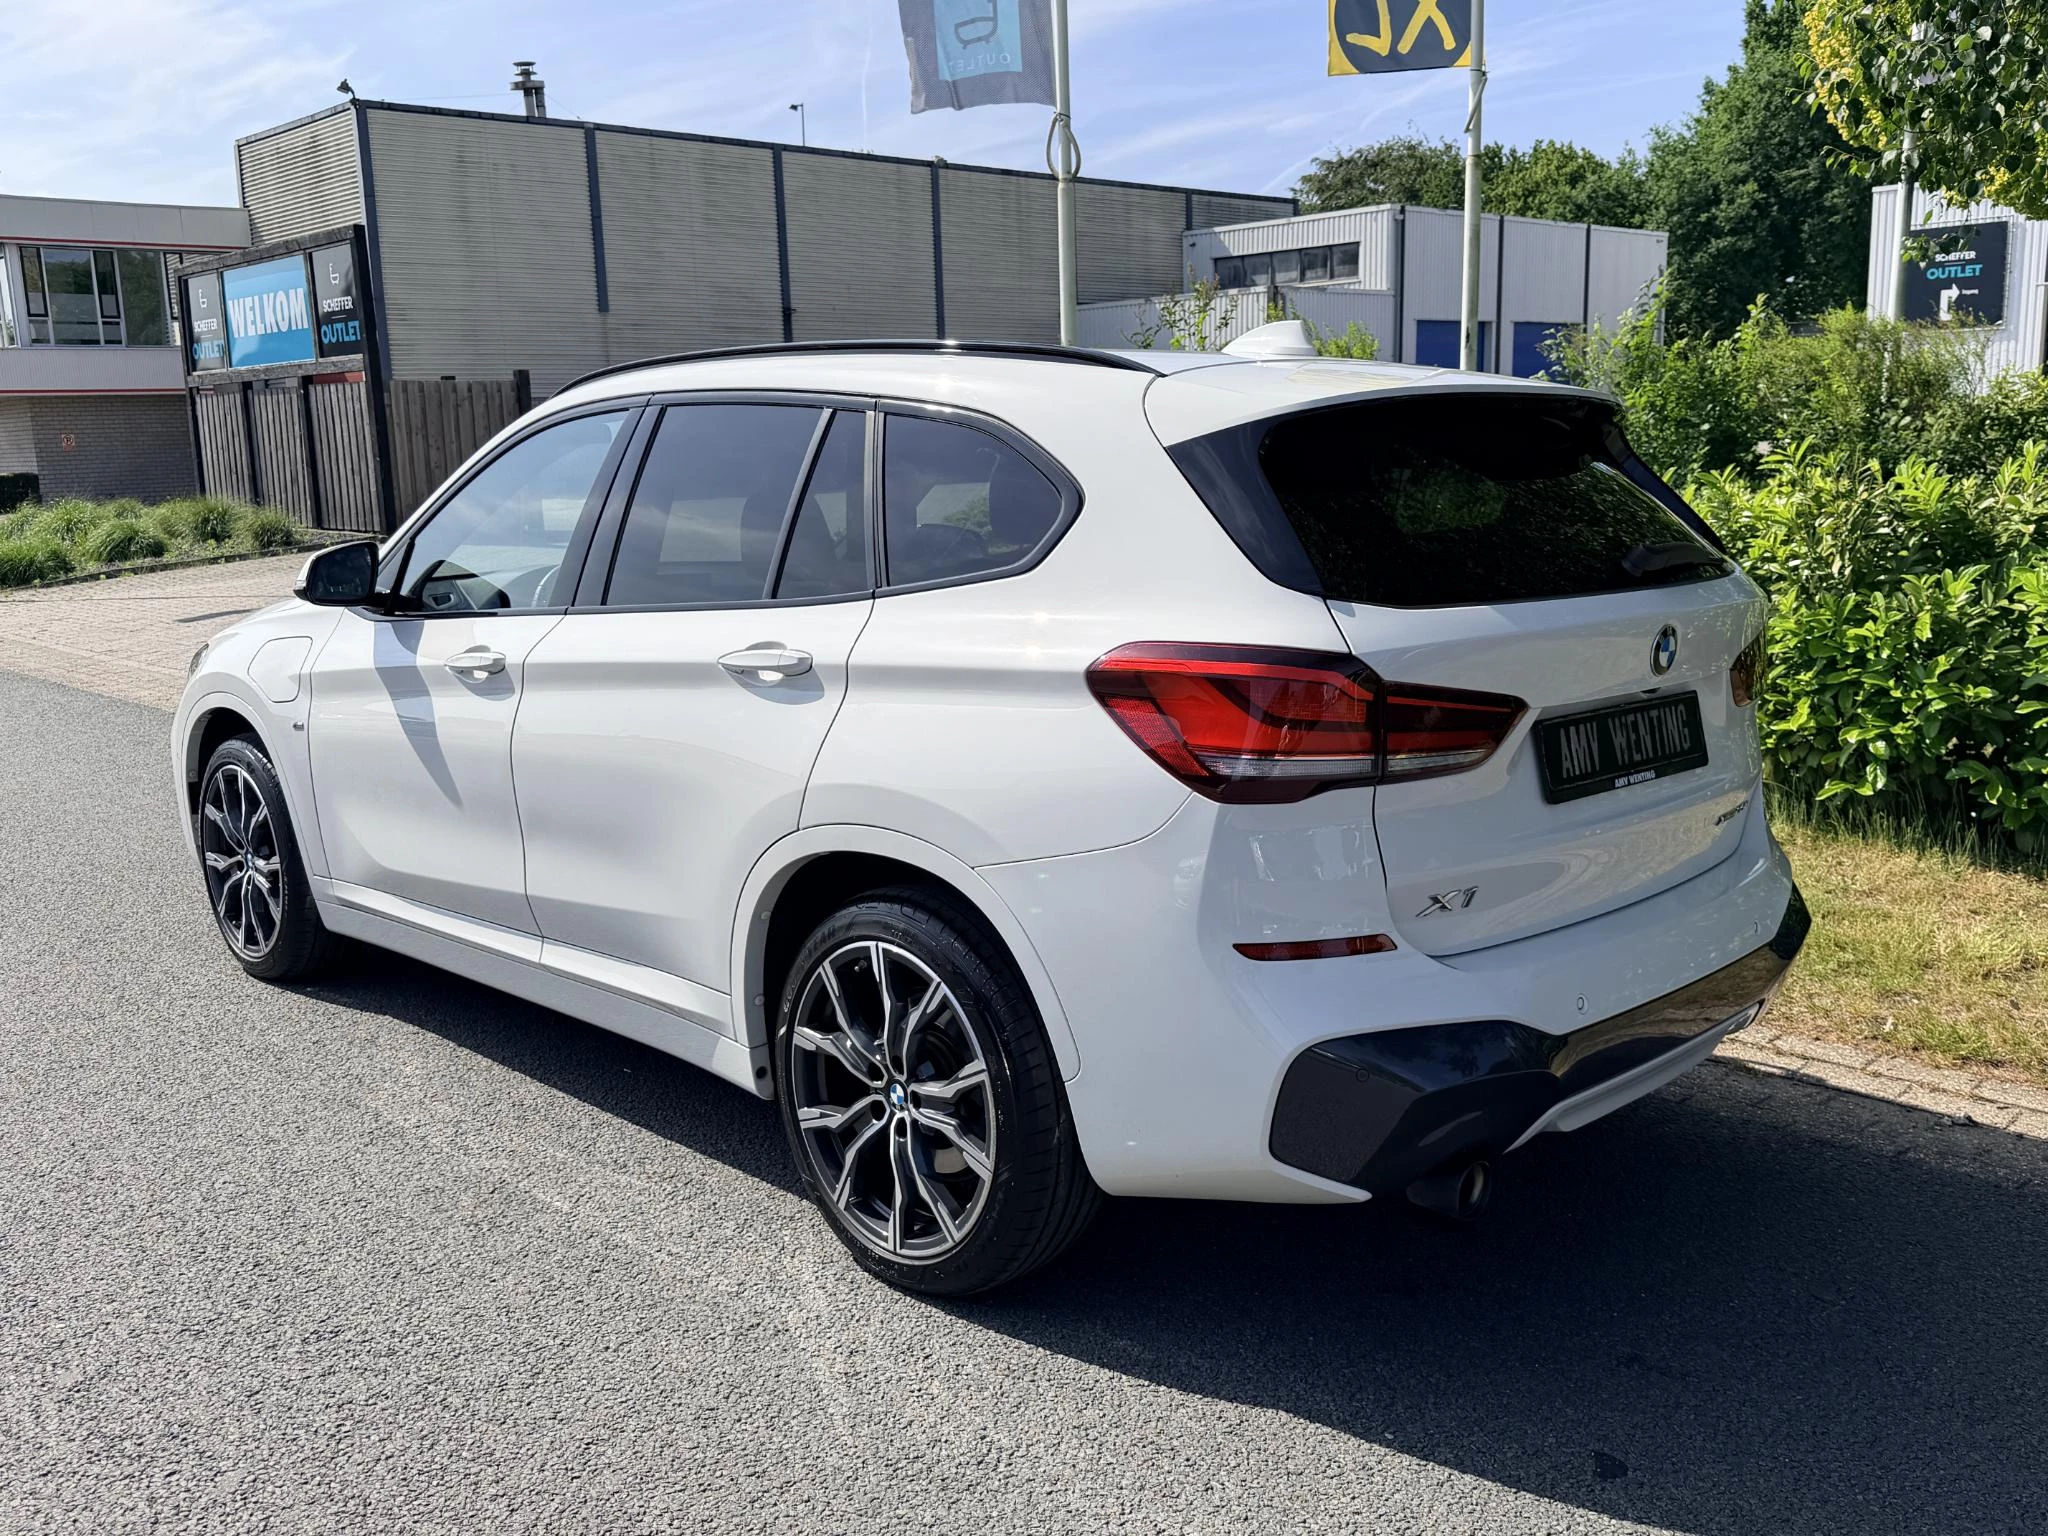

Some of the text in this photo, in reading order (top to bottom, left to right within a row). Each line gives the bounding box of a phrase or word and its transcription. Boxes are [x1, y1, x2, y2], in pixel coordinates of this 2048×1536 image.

[1926, 264, 1983, 280] OUTLET
[229, 288, 309, 338] WELKOM
[323, 296, 354, 312] SCHEFFER
[194, 319, 218, 333] SCHEFFER
[321, 320, 361, 345] OUTLET
[192, 340, 225, 360] OUTLET
[1560, 704, 1691, 779] AMY WENTING
[1614, 770, 1656, 788] AMY WENTING
[1415, 885, 1479, 918] X1
